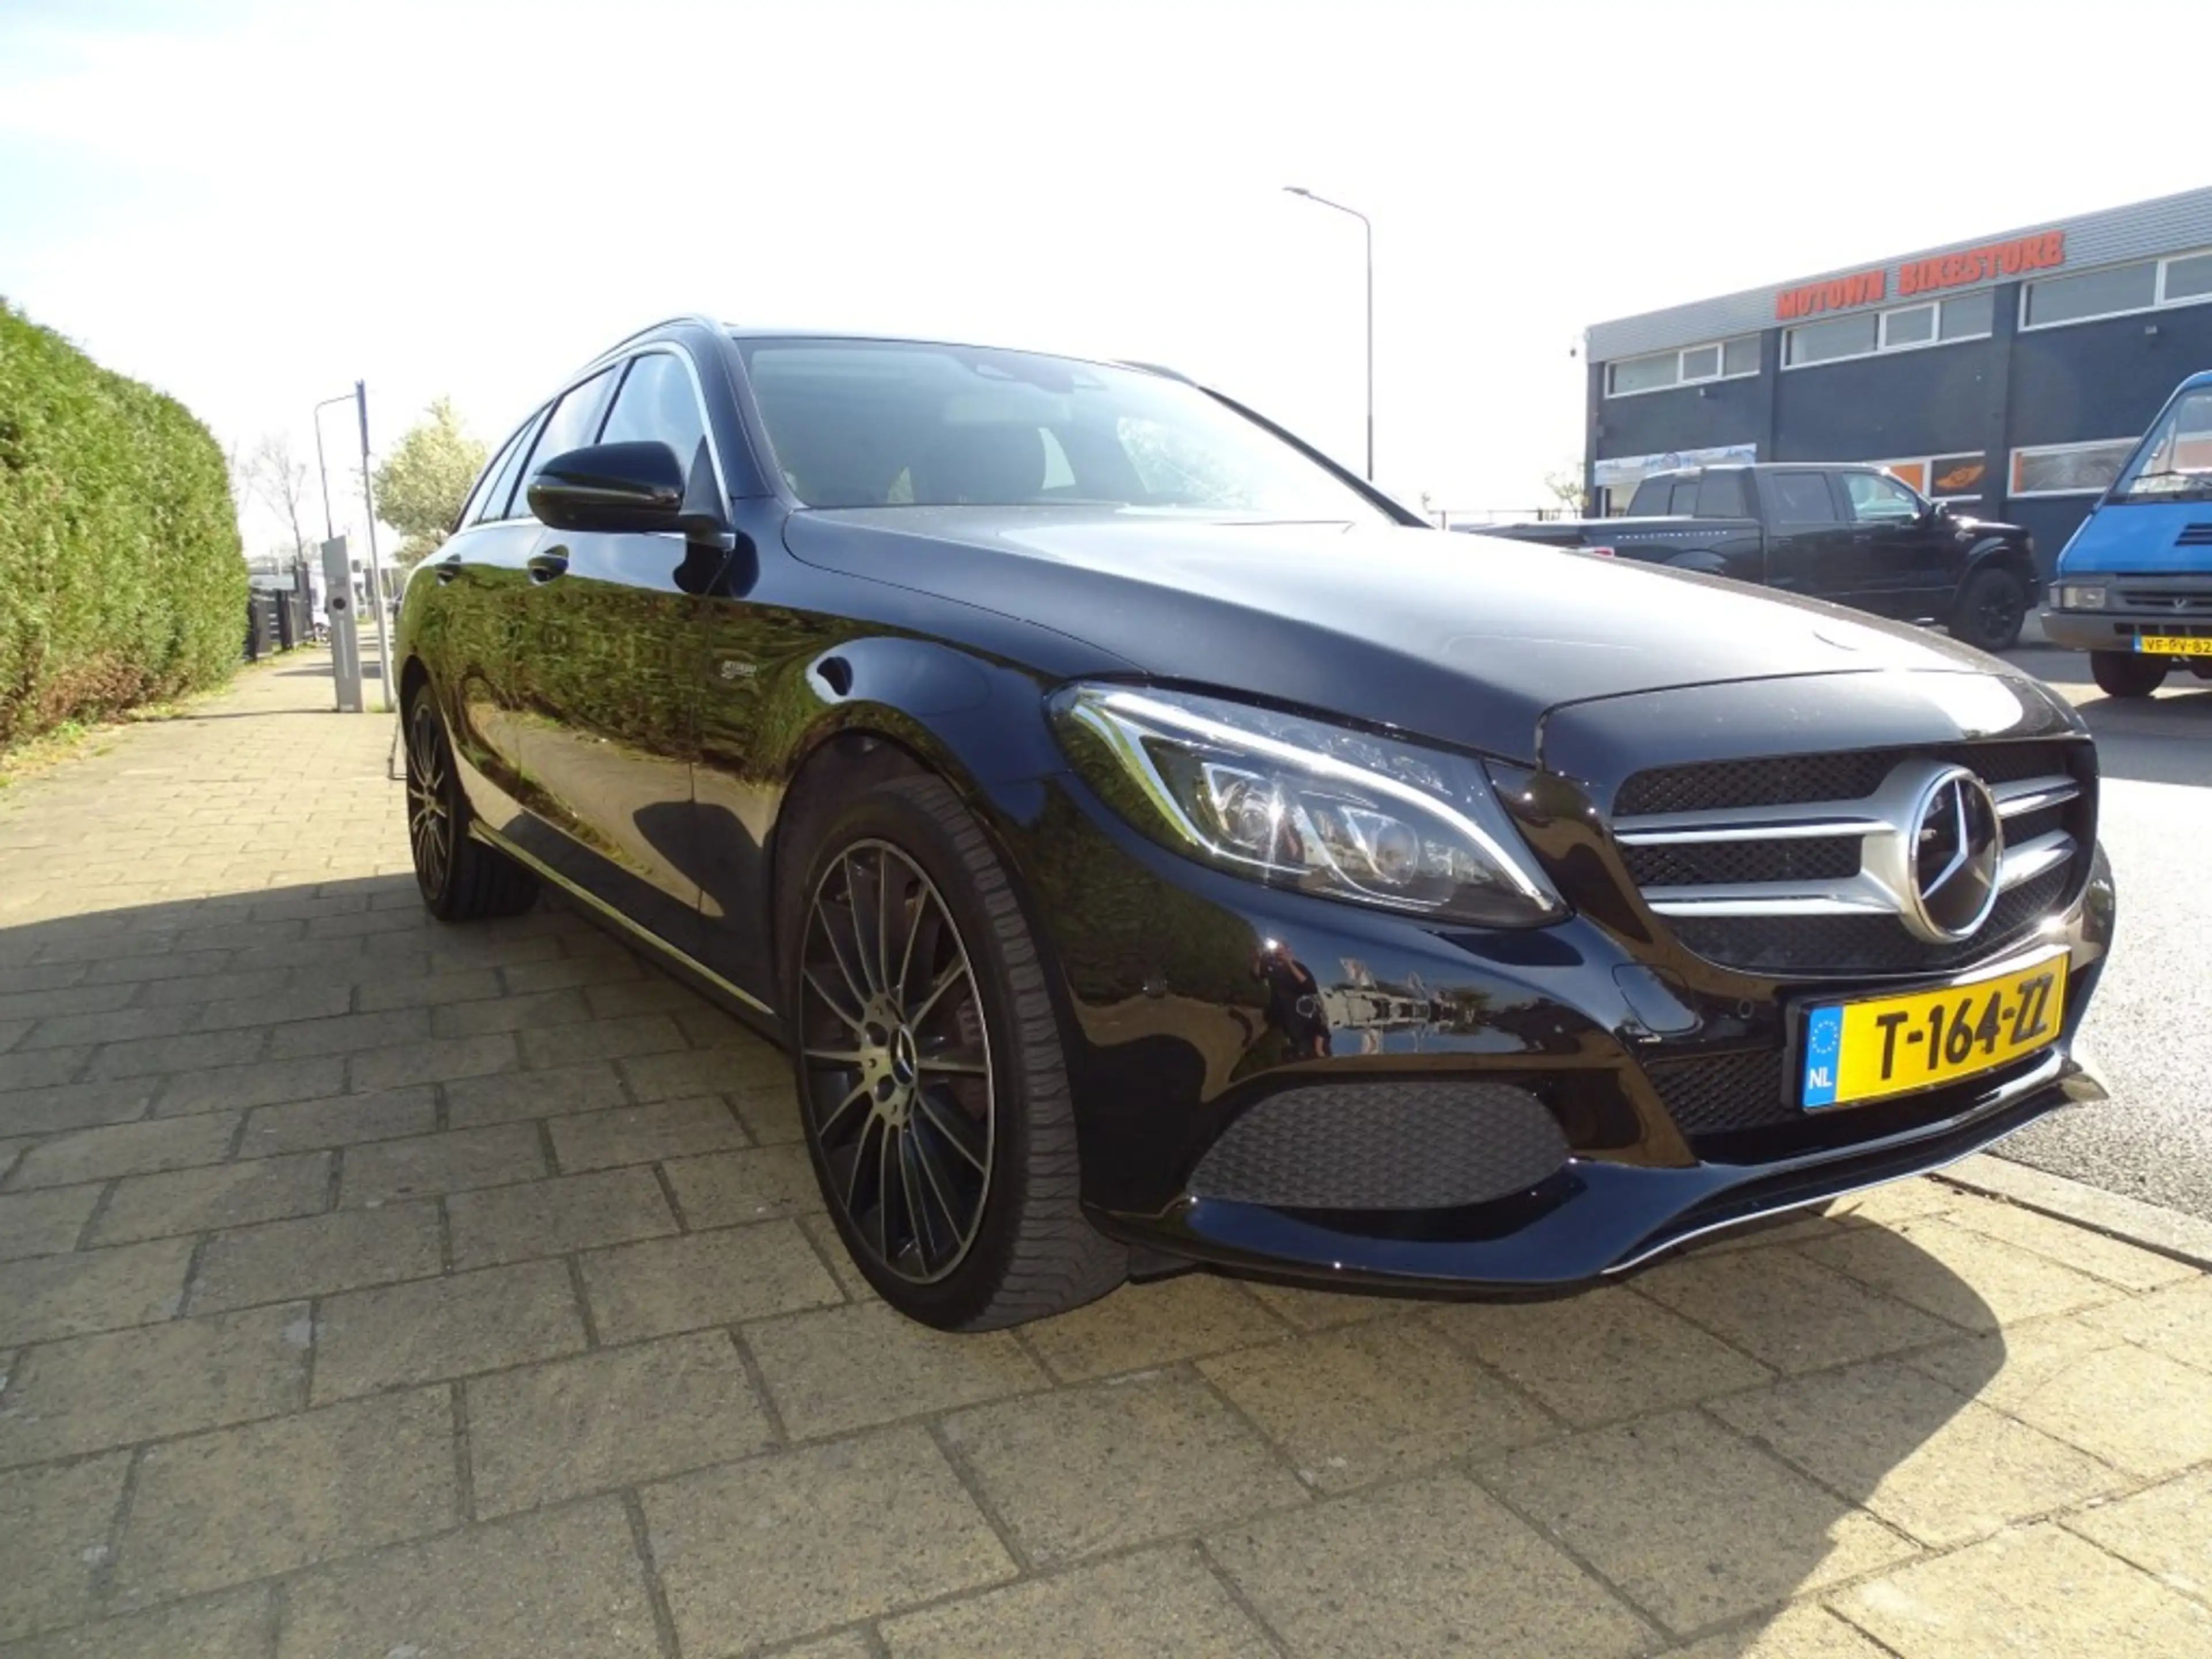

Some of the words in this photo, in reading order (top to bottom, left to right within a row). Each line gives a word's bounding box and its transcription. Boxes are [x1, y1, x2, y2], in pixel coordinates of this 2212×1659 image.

[1775, 270, 1886, 321] MOTOWN
[1896, 231, 2065, 296] BIKESTORE
[1876, 972, 2055, 1081] T-164-ZZ
[1808, 1068, 1832, 1089] NL
